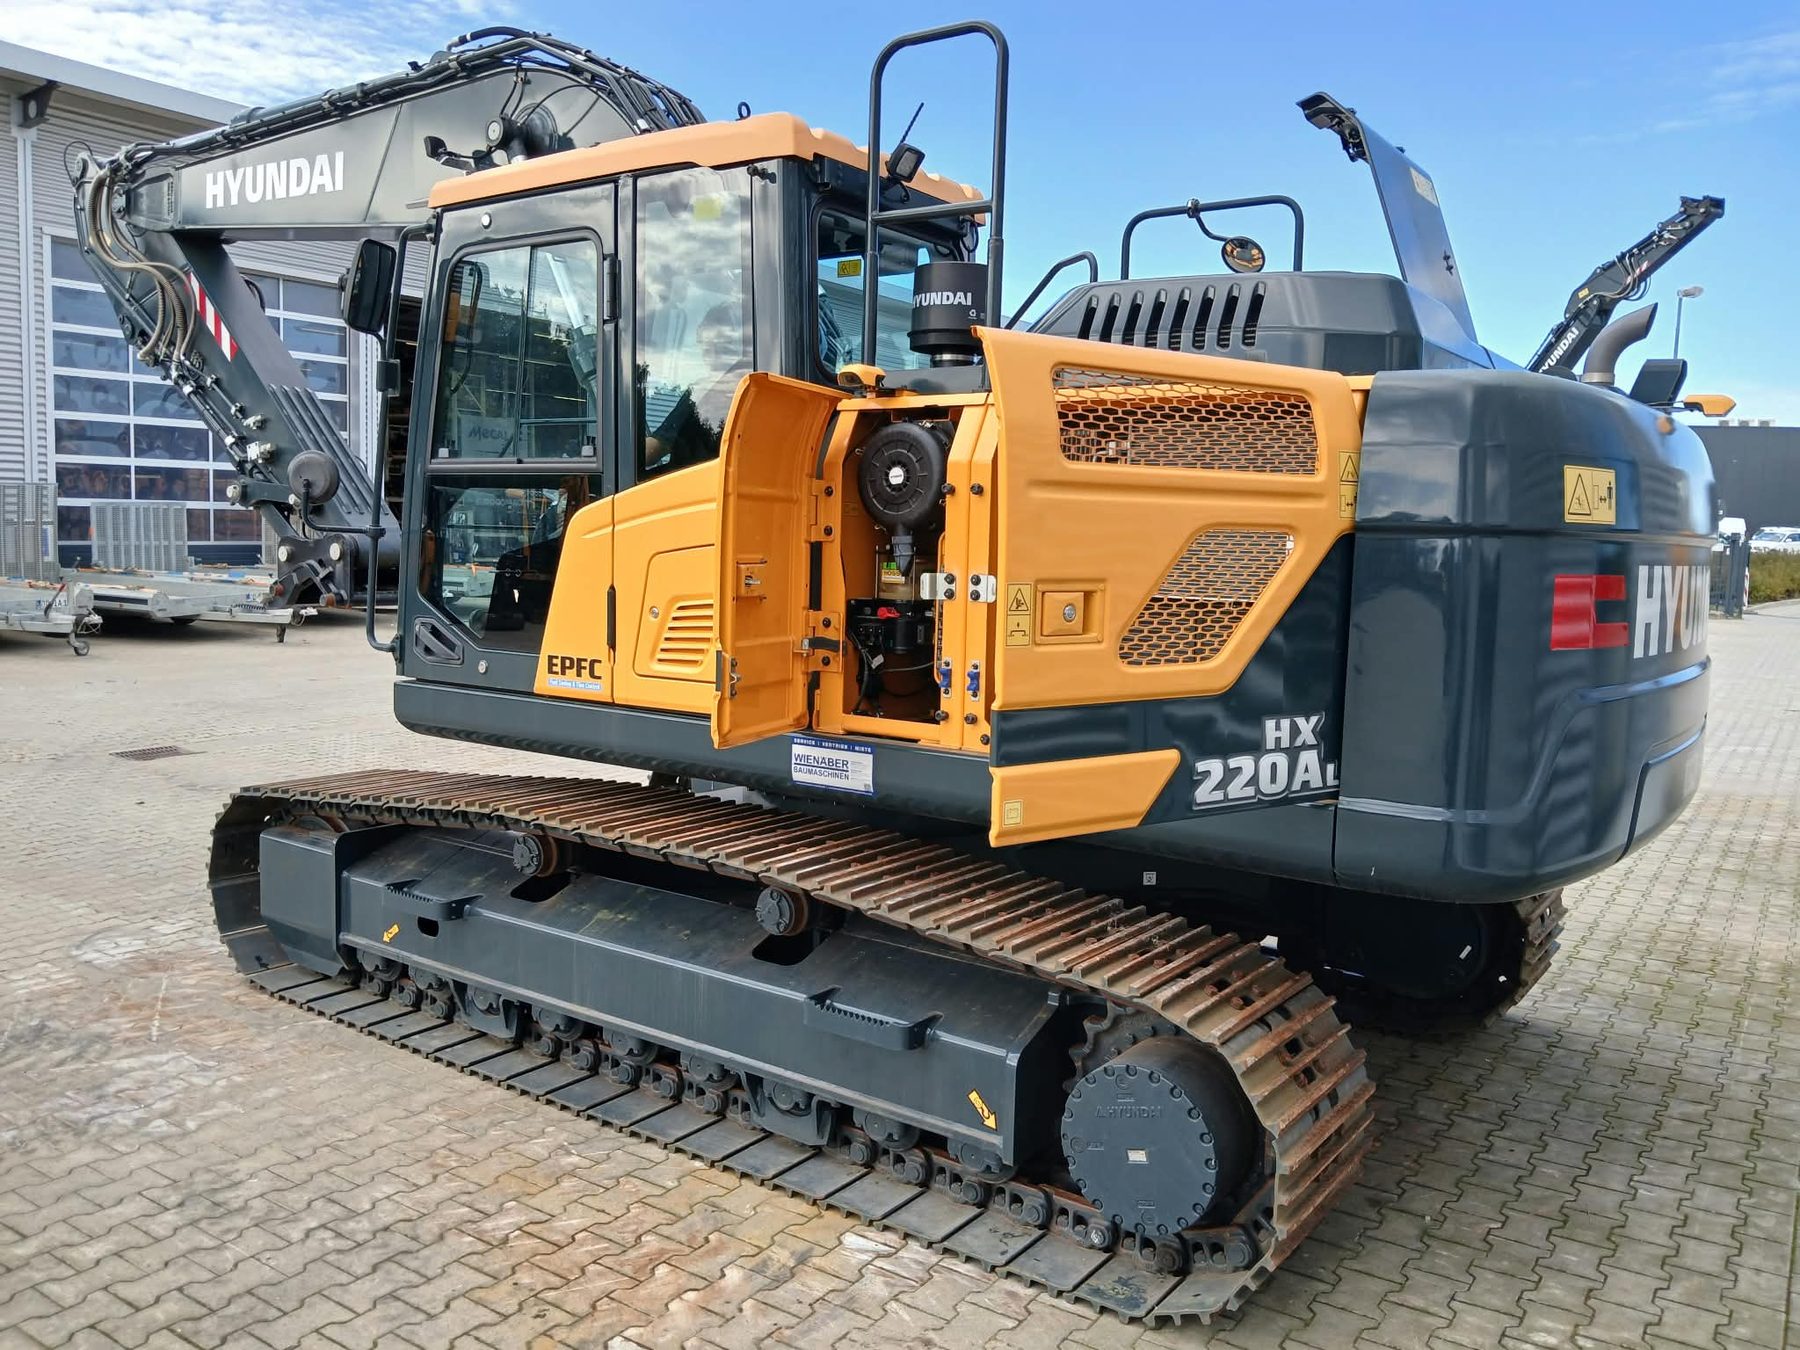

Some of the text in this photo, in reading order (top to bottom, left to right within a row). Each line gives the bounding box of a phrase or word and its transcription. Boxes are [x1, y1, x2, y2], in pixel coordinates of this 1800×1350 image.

[205, 151, 344, 209] HYUNDAI
[1539, 327, 1579, 373] YUNDAI
[547, 655, 602, 680] EPFC
[1265, 715, 1320, 750] HX
[793, 766, 850, 781] BAUMASCHINEN
